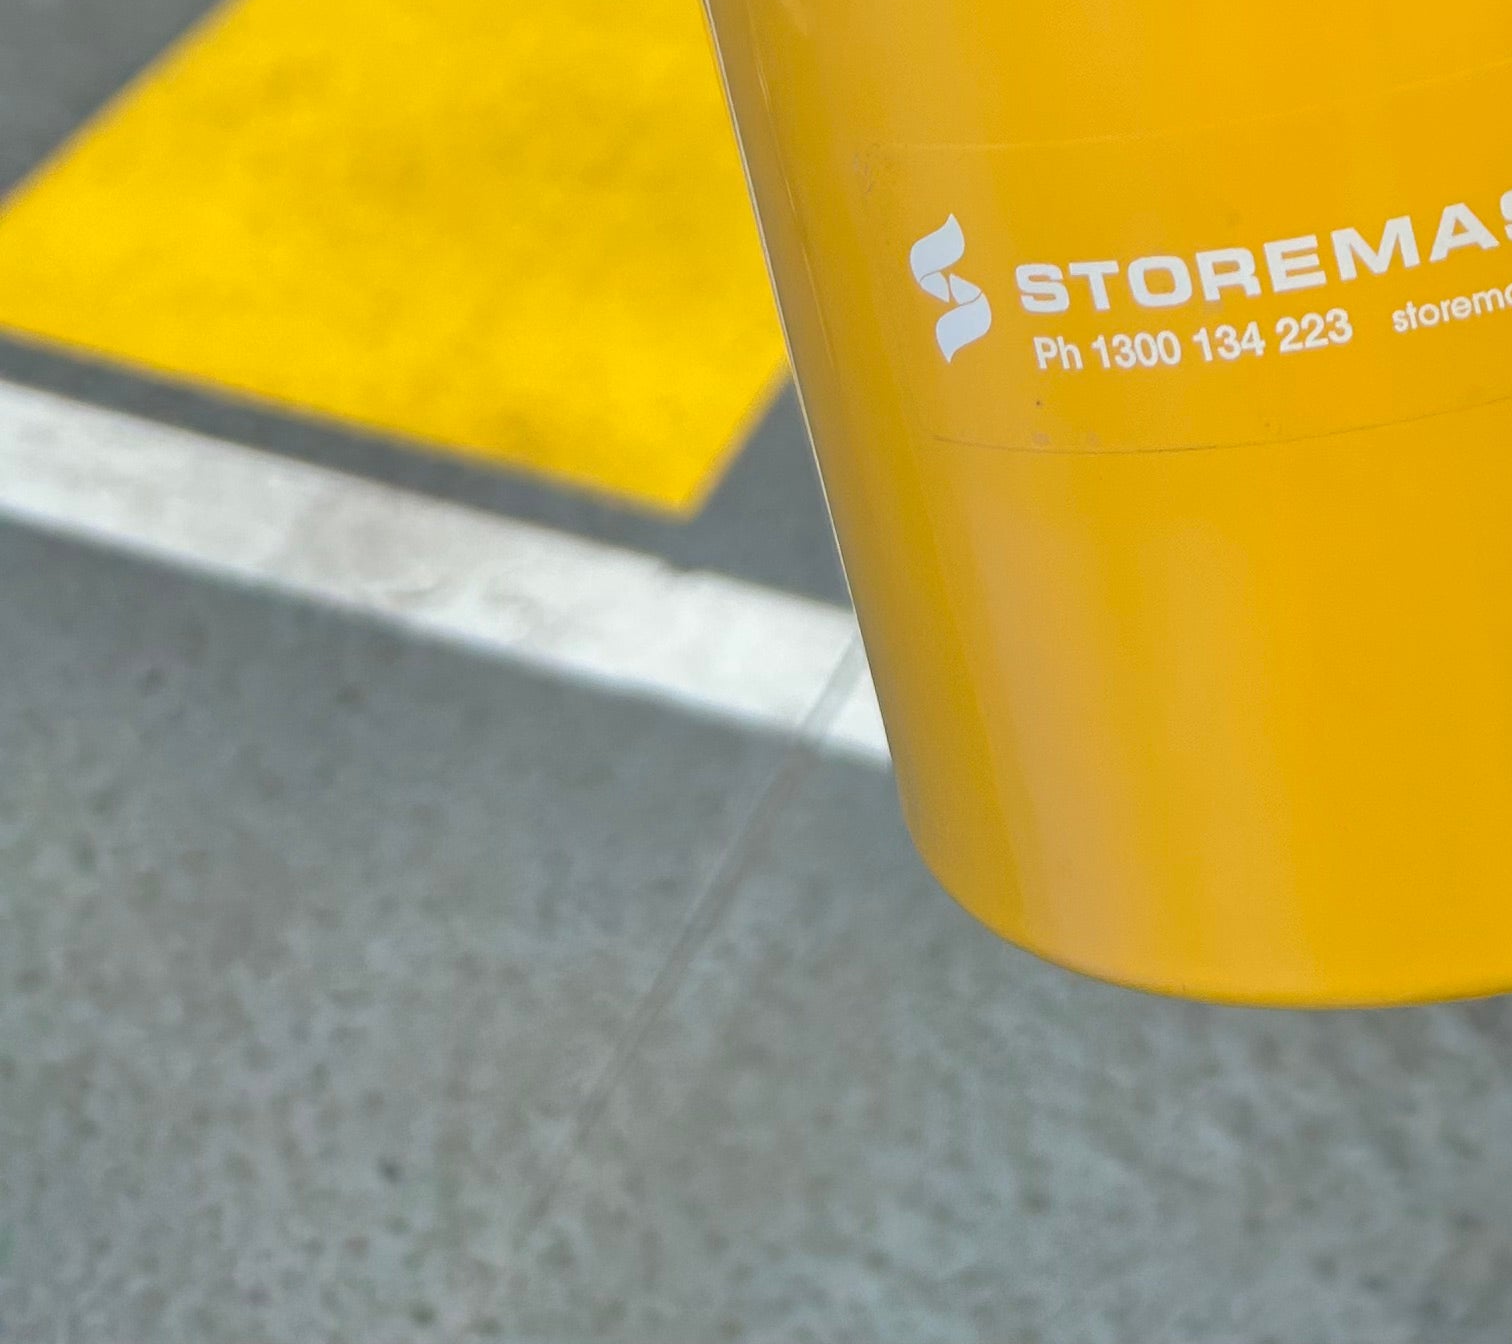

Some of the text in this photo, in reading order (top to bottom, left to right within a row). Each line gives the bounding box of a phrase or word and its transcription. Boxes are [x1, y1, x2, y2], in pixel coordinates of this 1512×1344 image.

[1032, 334, 1084, 371] Ph
[1091, 330, 1182, 370] 1300
[1191, 321, 1266, 363] 134
[1275, 308, 1353, 354] 223
